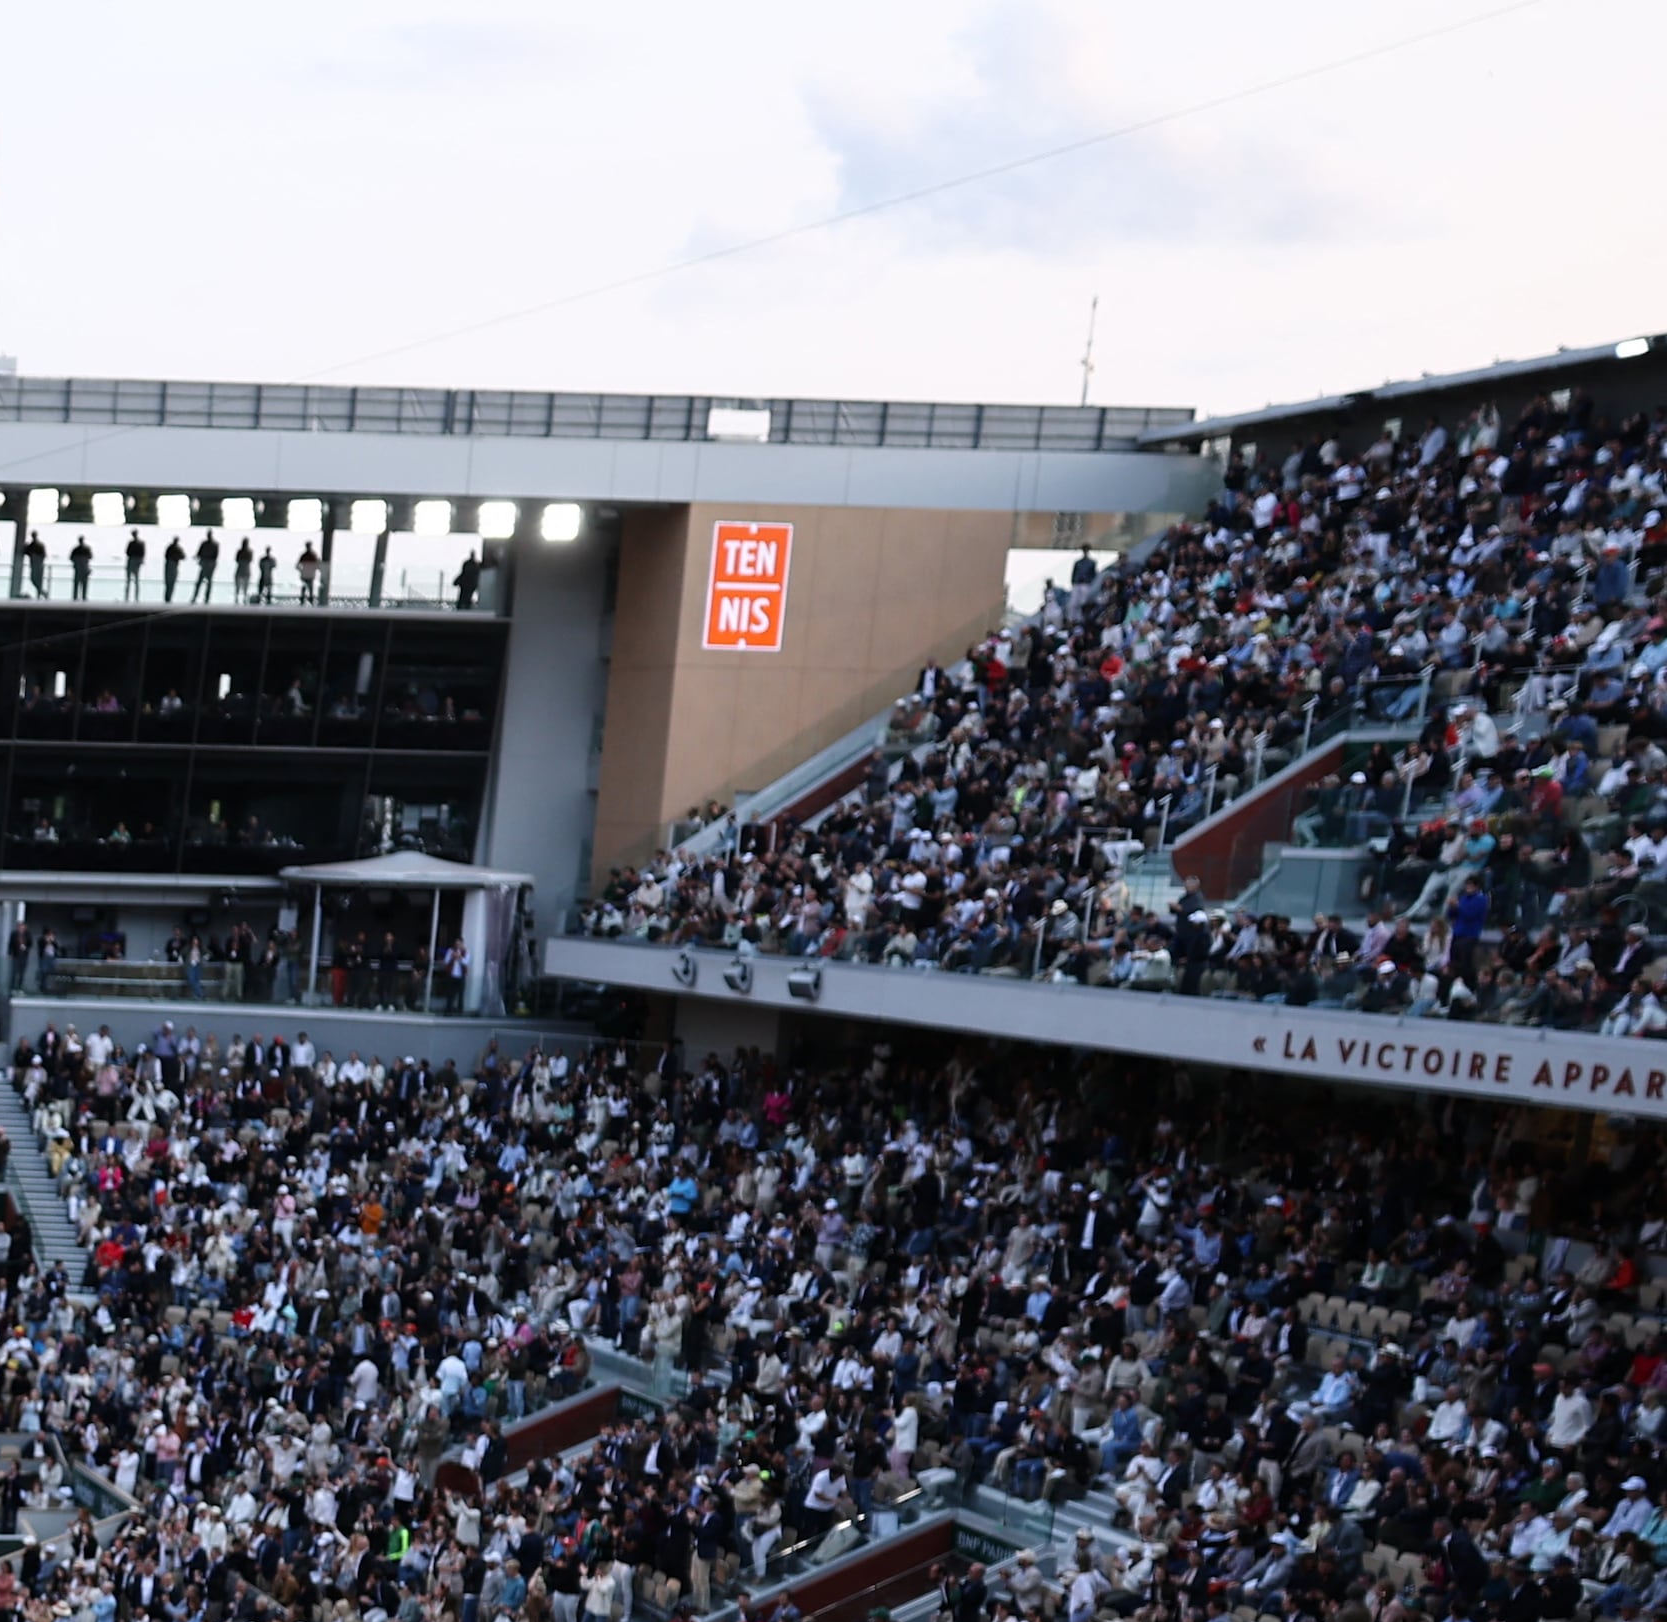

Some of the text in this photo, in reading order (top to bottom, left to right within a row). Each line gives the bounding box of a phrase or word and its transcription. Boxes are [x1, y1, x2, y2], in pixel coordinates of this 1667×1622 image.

[723, 539, 778, 577] TEN
[718, 596, 771, 634] NIS
[1283, 1030, 1318, 1062] LA
[1338, 1038, 1513, 1084] VICTOIRE
[1532, 1059, 1666, 1100] APPAR
